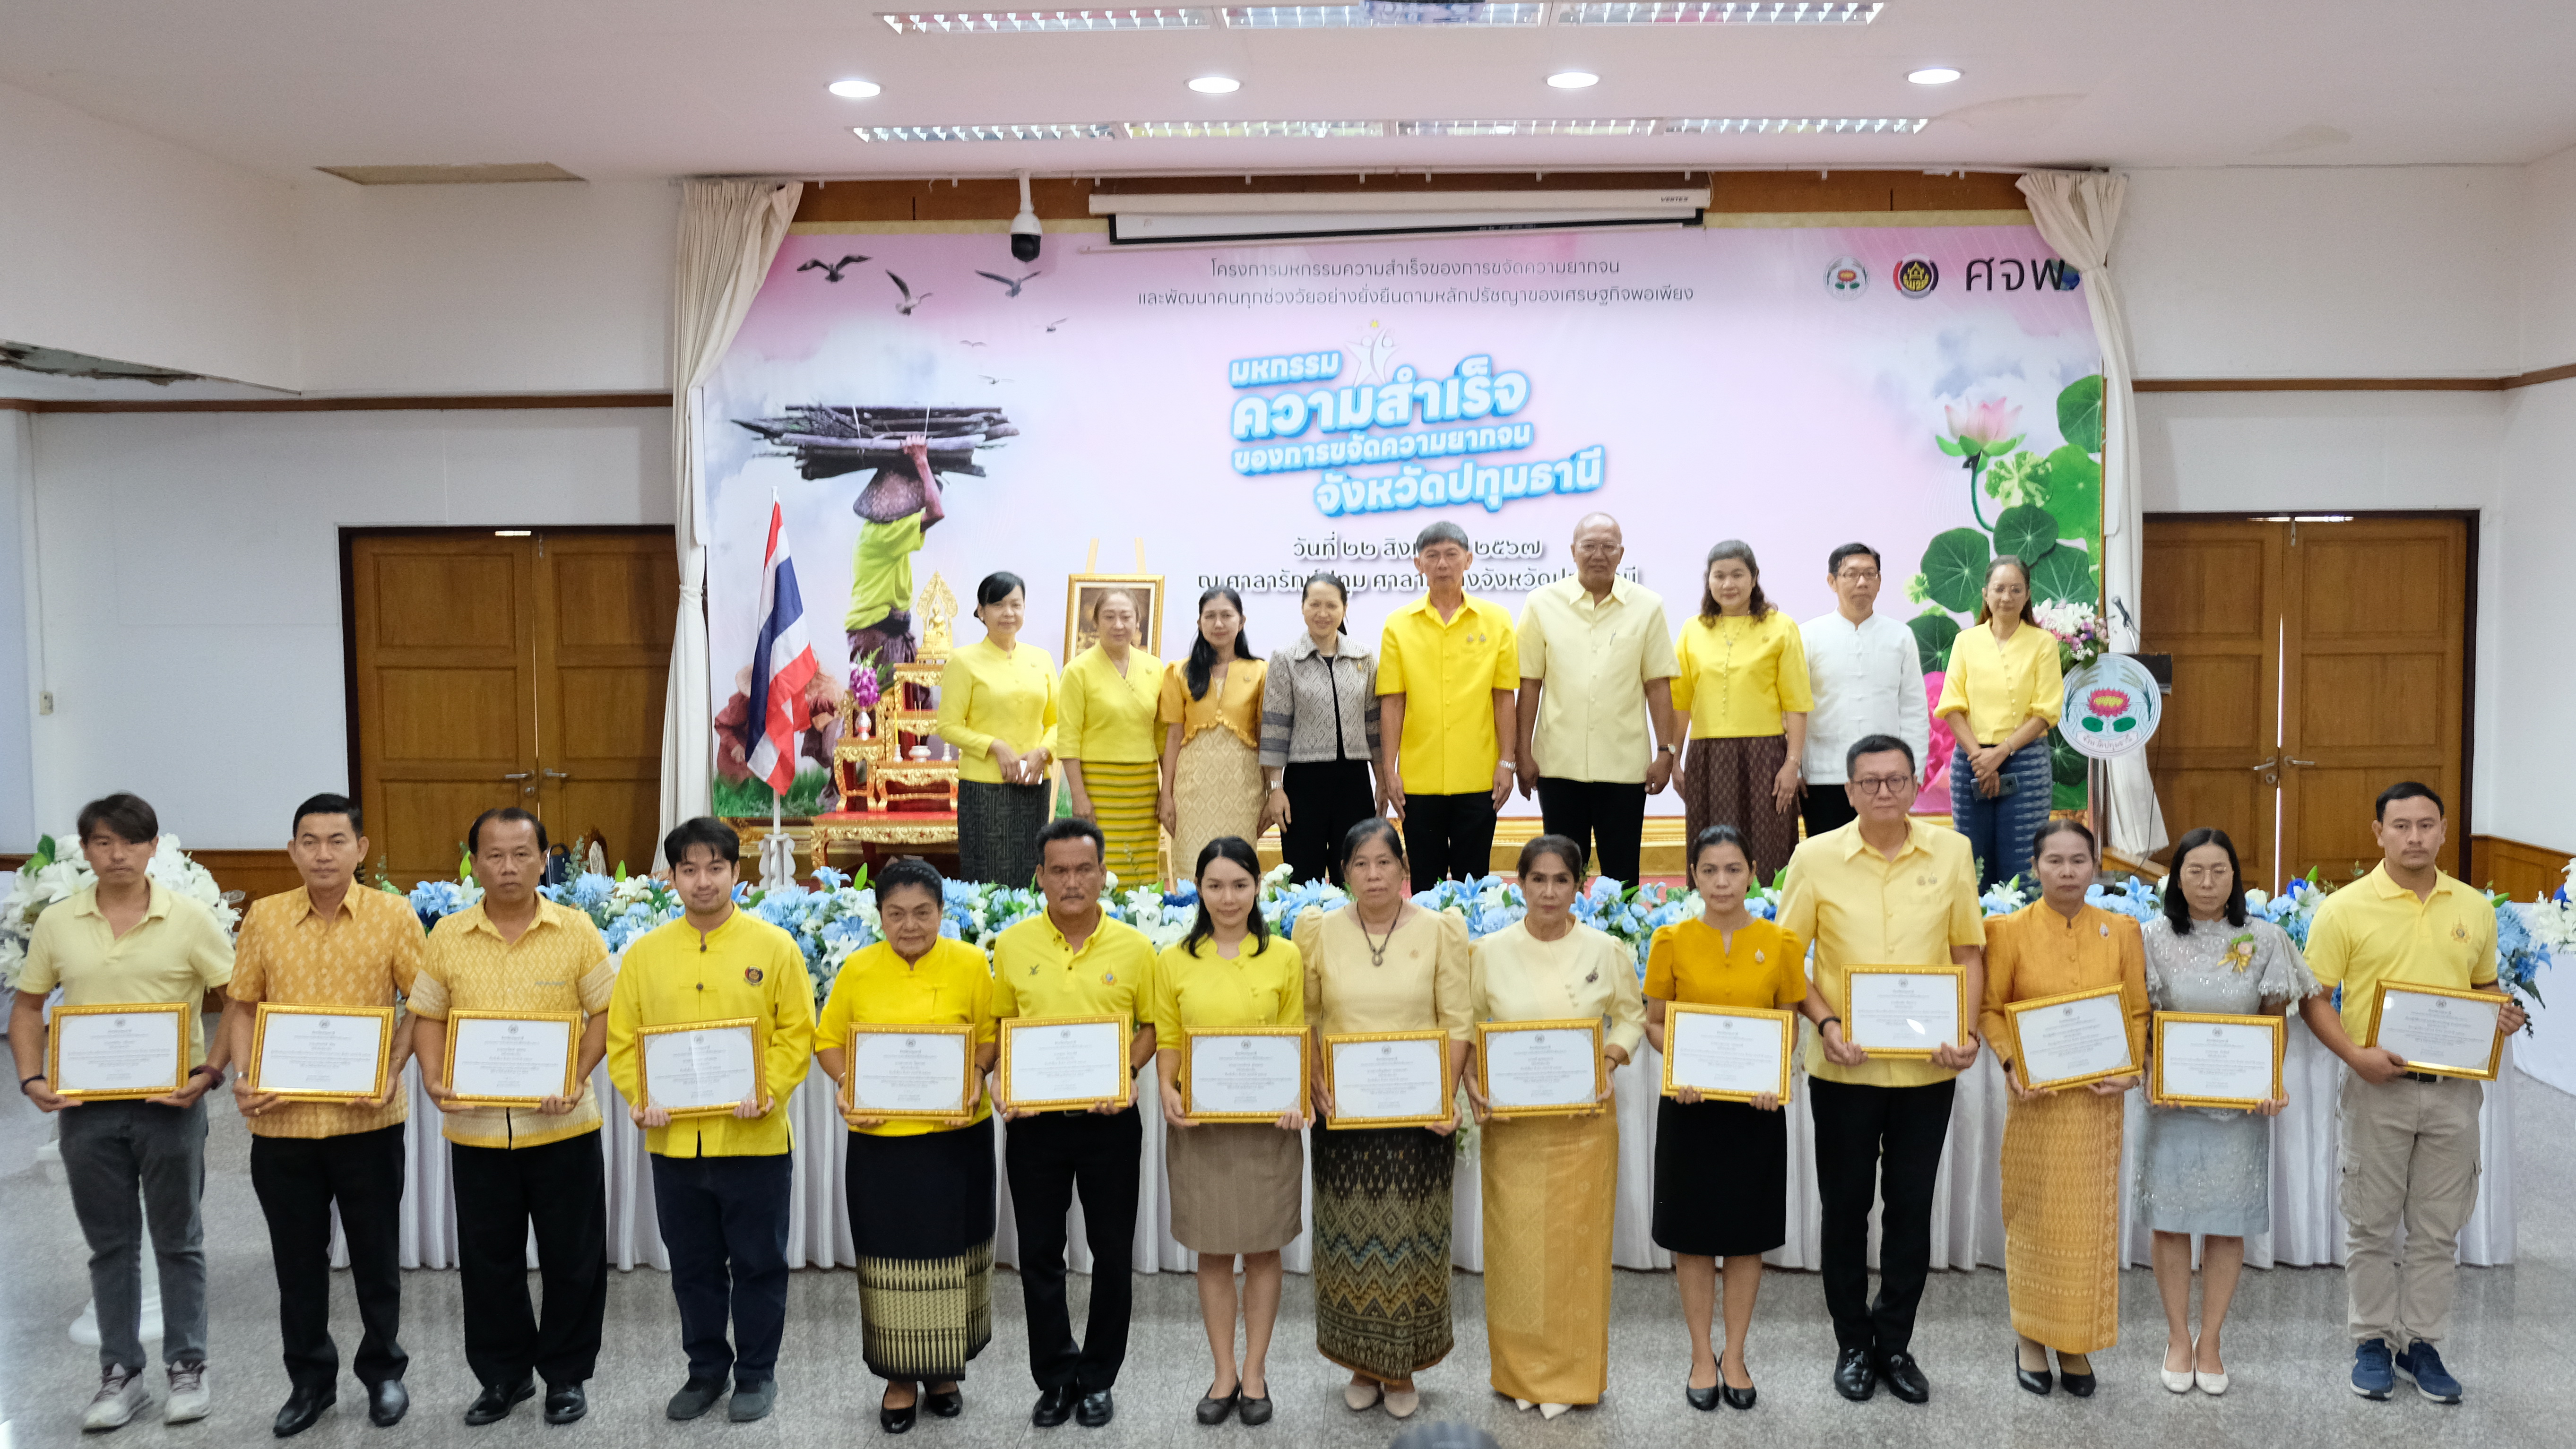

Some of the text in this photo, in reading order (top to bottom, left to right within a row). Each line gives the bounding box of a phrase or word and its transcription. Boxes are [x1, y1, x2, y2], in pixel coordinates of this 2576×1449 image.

[1211, 257, 1620, 277] โครงการมหกรรมความสำเร็จของการขจัดความยากจน
[1966, 257, 2065, 291] ศจพ
[1138, 284, 1694, 309] และพัฒนาคนทุกช่วงวัยอย่างยั่งยืนตามหลักปรัชญาของเศรษฐกิจพอเพียง
[1231, 353, 1340, 384] มหกรรม
[1232, 355, 1529, 438] ความสำเร็จ
[1233, 423, 1532, 471] ของการขจัดความยากจน
[1315, 445, 1603, 511] จังหวัดปทุมธานี
[1294, 531, 1338, 556] วันที่
[1343, 541, 1375, 556] ๒๒
[1475, 539, 1540, 555] ๒๕๖๗
